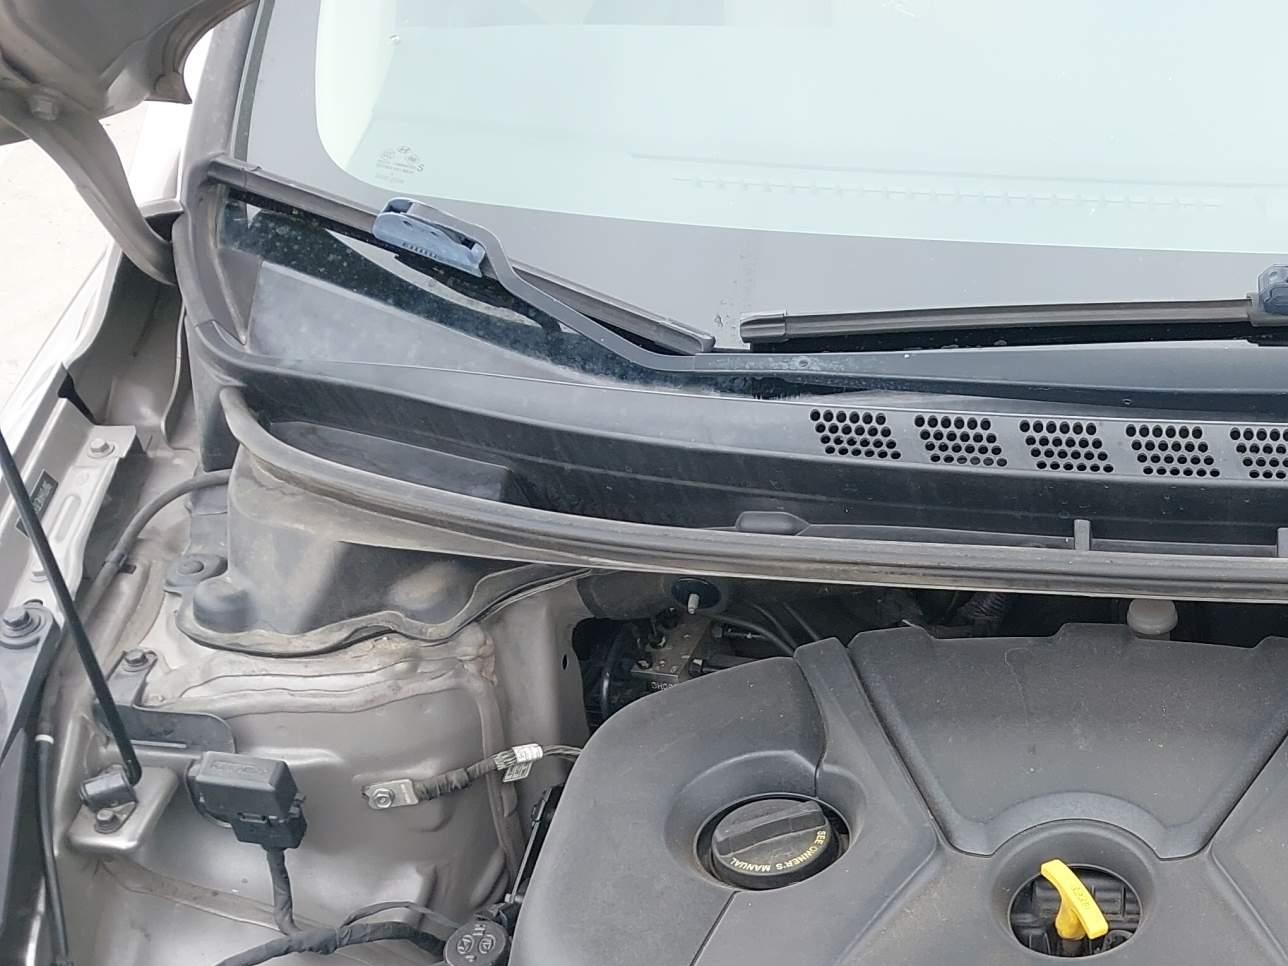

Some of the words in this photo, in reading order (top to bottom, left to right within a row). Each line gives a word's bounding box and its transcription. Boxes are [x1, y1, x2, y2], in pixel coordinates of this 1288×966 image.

[814, 830, 827, 845] SEE
[729, 857, 772, 872] MANUAL
[776, 846, 818, 870] OWNER'S
